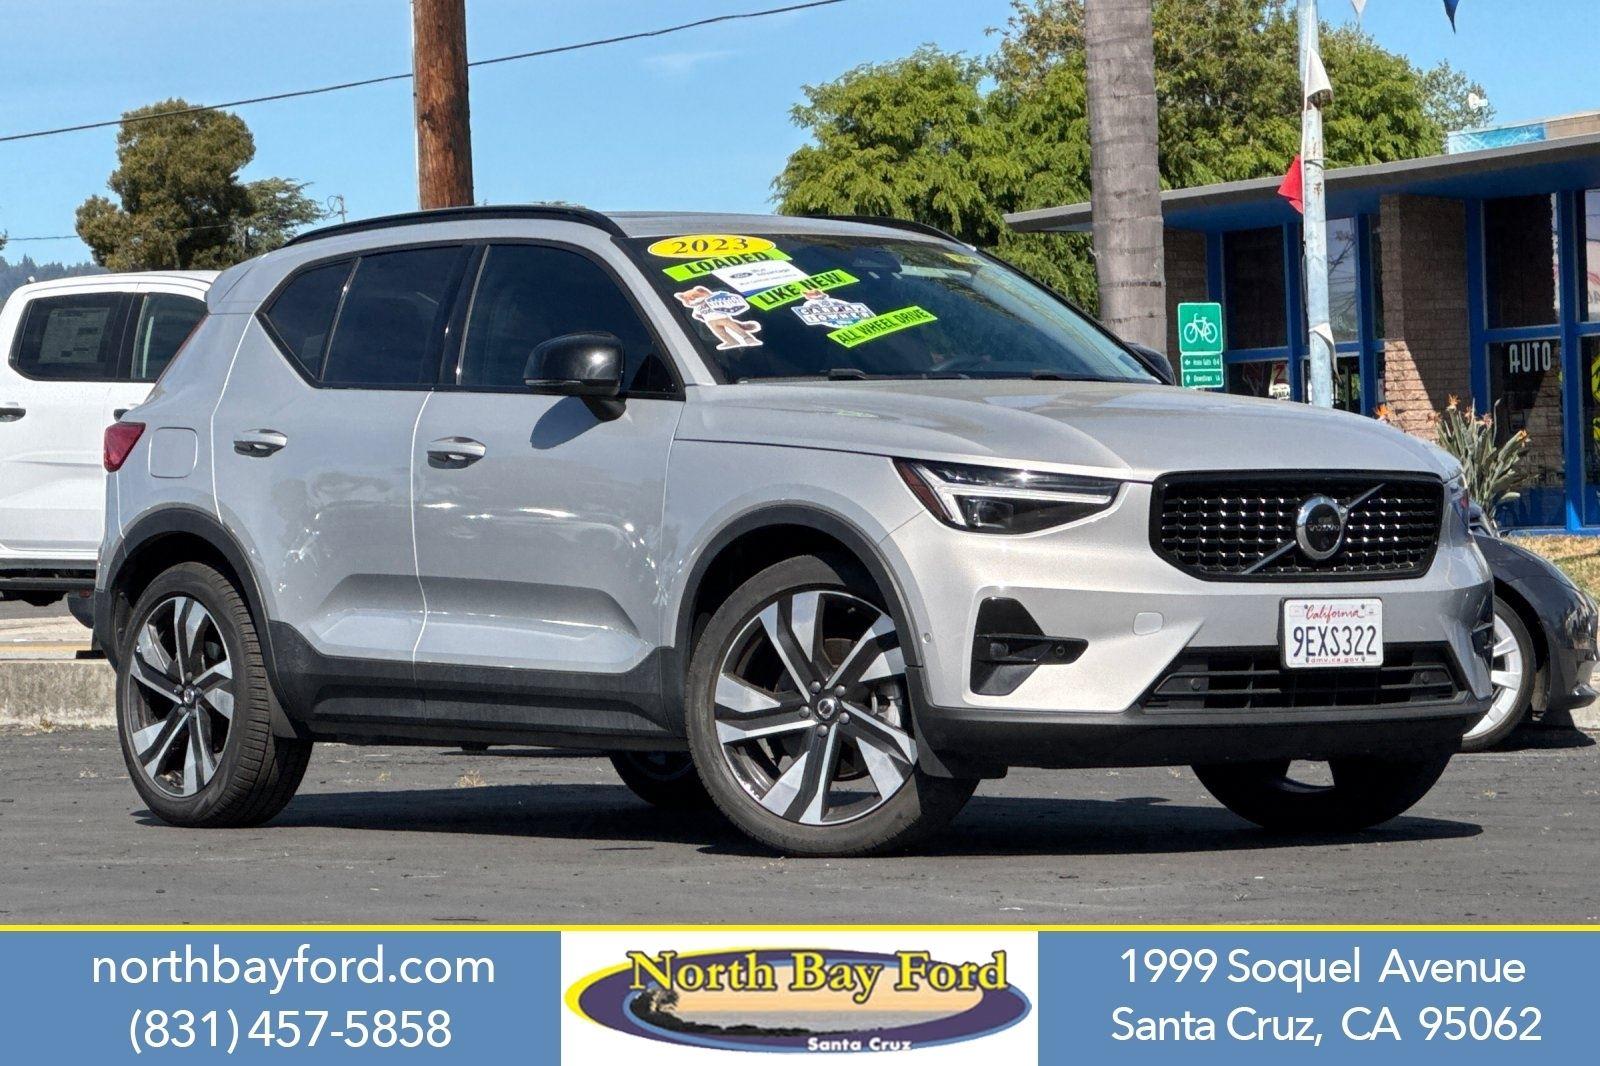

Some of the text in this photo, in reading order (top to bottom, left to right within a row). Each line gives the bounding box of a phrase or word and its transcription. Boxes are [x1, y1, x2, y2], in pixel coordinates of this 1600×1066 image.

[672, 238, 749, 254] 2023
[685, 251, 770, 275] LOADED
[758, 283, 801, 306] LIKE
[799, 271, 843, 292] NEW
[836, 308, 929, 344] ALL WHEEL DRIVE
[1509, 341, 1552, 374] AUTO
[1305, 604, 1364, 624] California
[1293, 625, 1376, 657] 9EXS322
